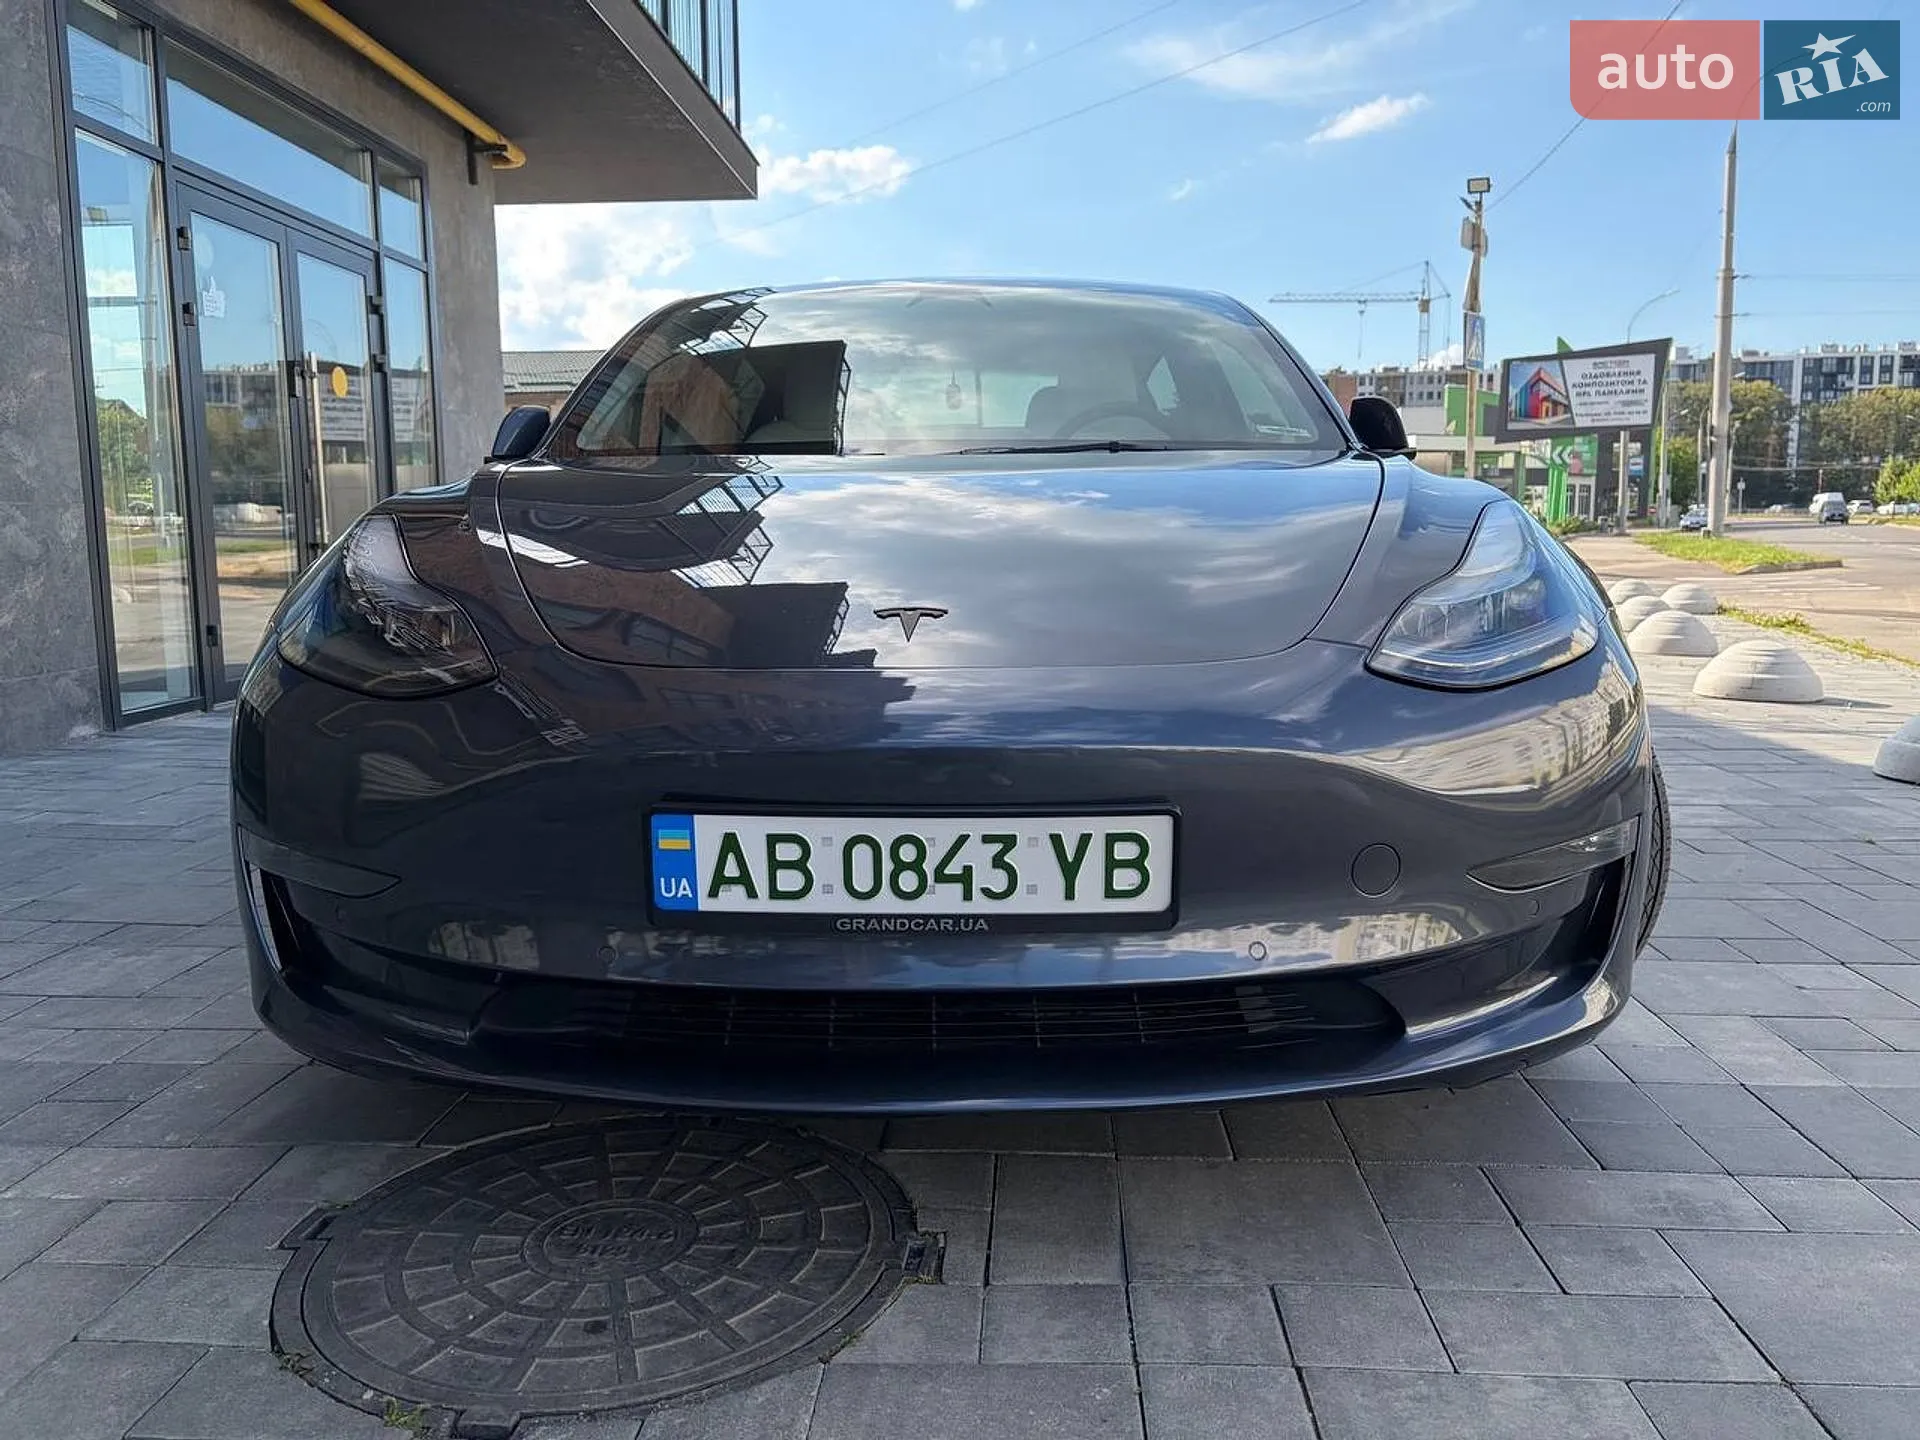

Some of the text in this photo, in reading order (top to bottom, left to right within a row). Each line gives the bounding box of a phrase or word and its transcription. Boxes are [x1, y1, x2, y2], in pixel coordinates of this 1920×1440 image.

[707, 831, 1152, 902] AB 0843 YB
[660, 878, 693, 898] UA
[836, 917, 989, 933] GRANDCAR.UA
